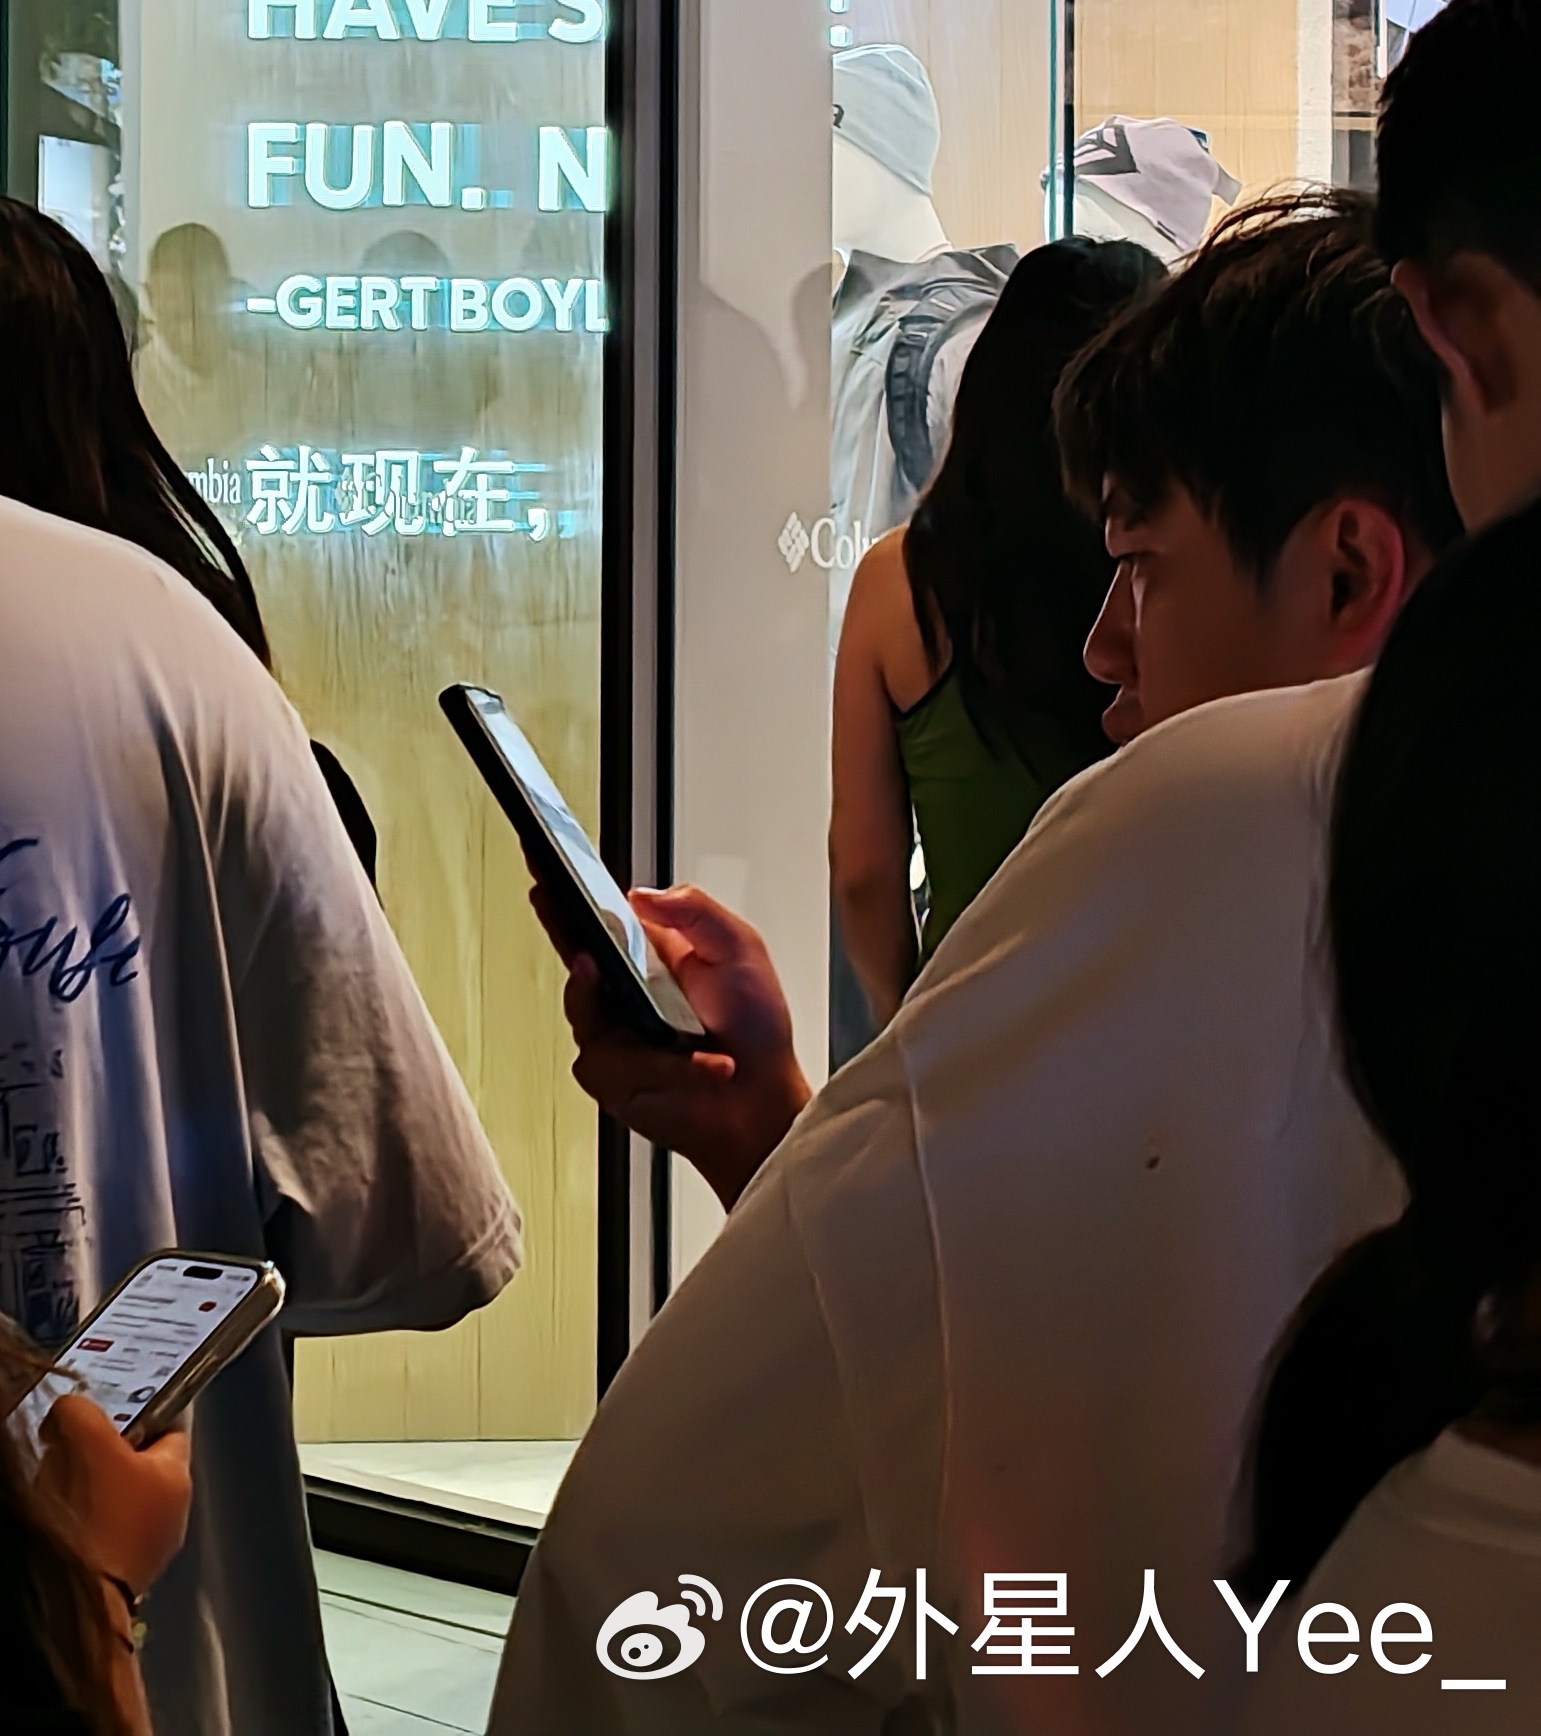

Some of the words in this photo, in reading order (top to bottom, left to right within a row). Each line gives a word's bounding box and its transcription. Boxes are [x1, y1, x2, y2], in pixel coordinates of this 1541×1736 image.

[247, 120, 485, 212] FUN.
[449, 276, 611, 333] BOYL
[185, 457, 242, 504] mbia
[810, 516, 880, 570] Col
